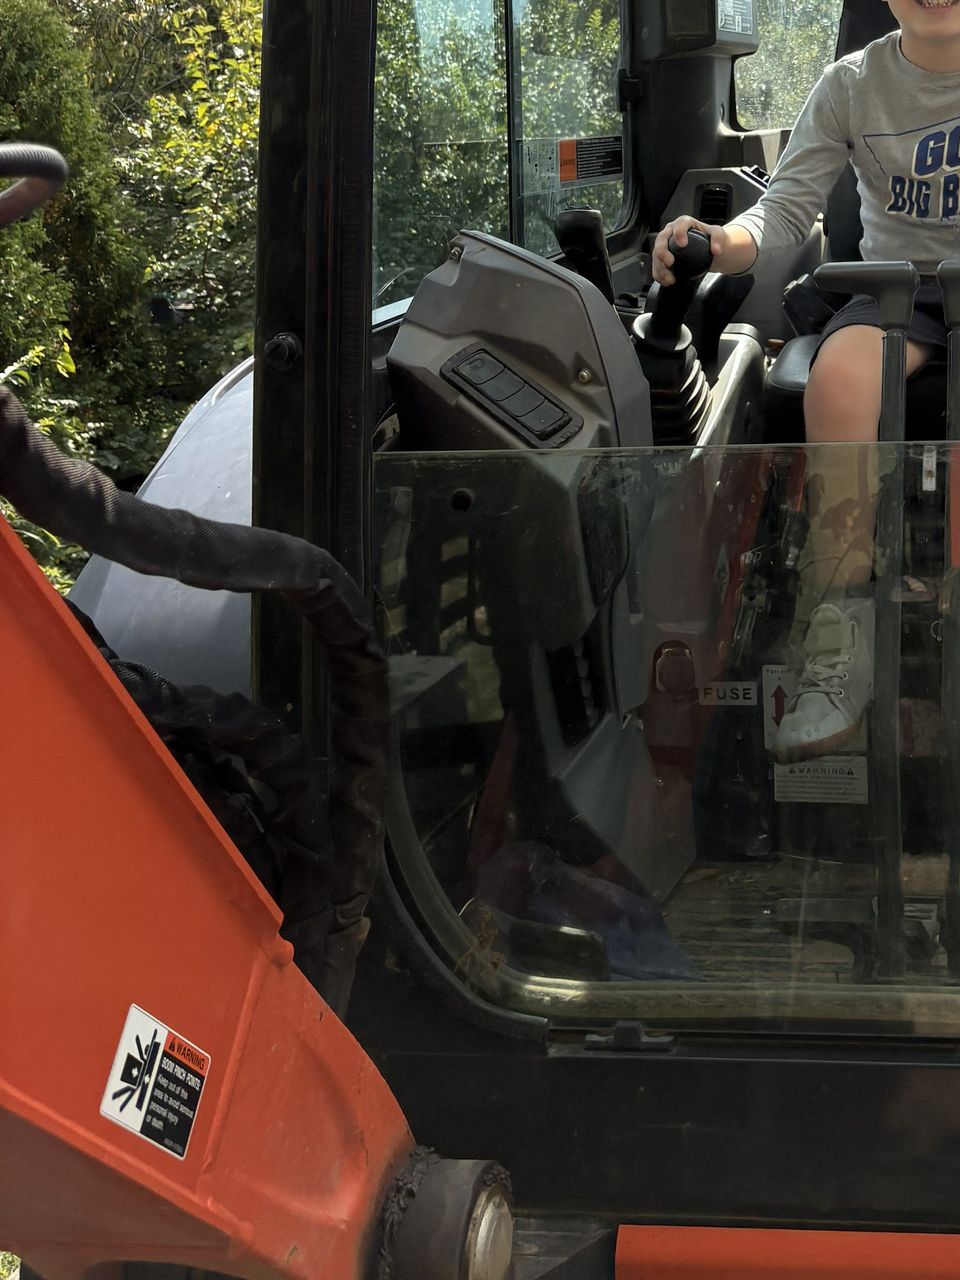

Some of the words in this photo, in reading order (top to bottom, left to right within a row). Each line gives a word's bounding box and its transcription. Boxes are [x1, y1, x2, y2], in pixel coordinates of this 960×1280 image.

[885, 175, 931, 219] BIG
[703, 687, 753, 702] FUSE
[798, 767, 845, 776] WARNING
[175, 1043, 205, 1070] WARNING
